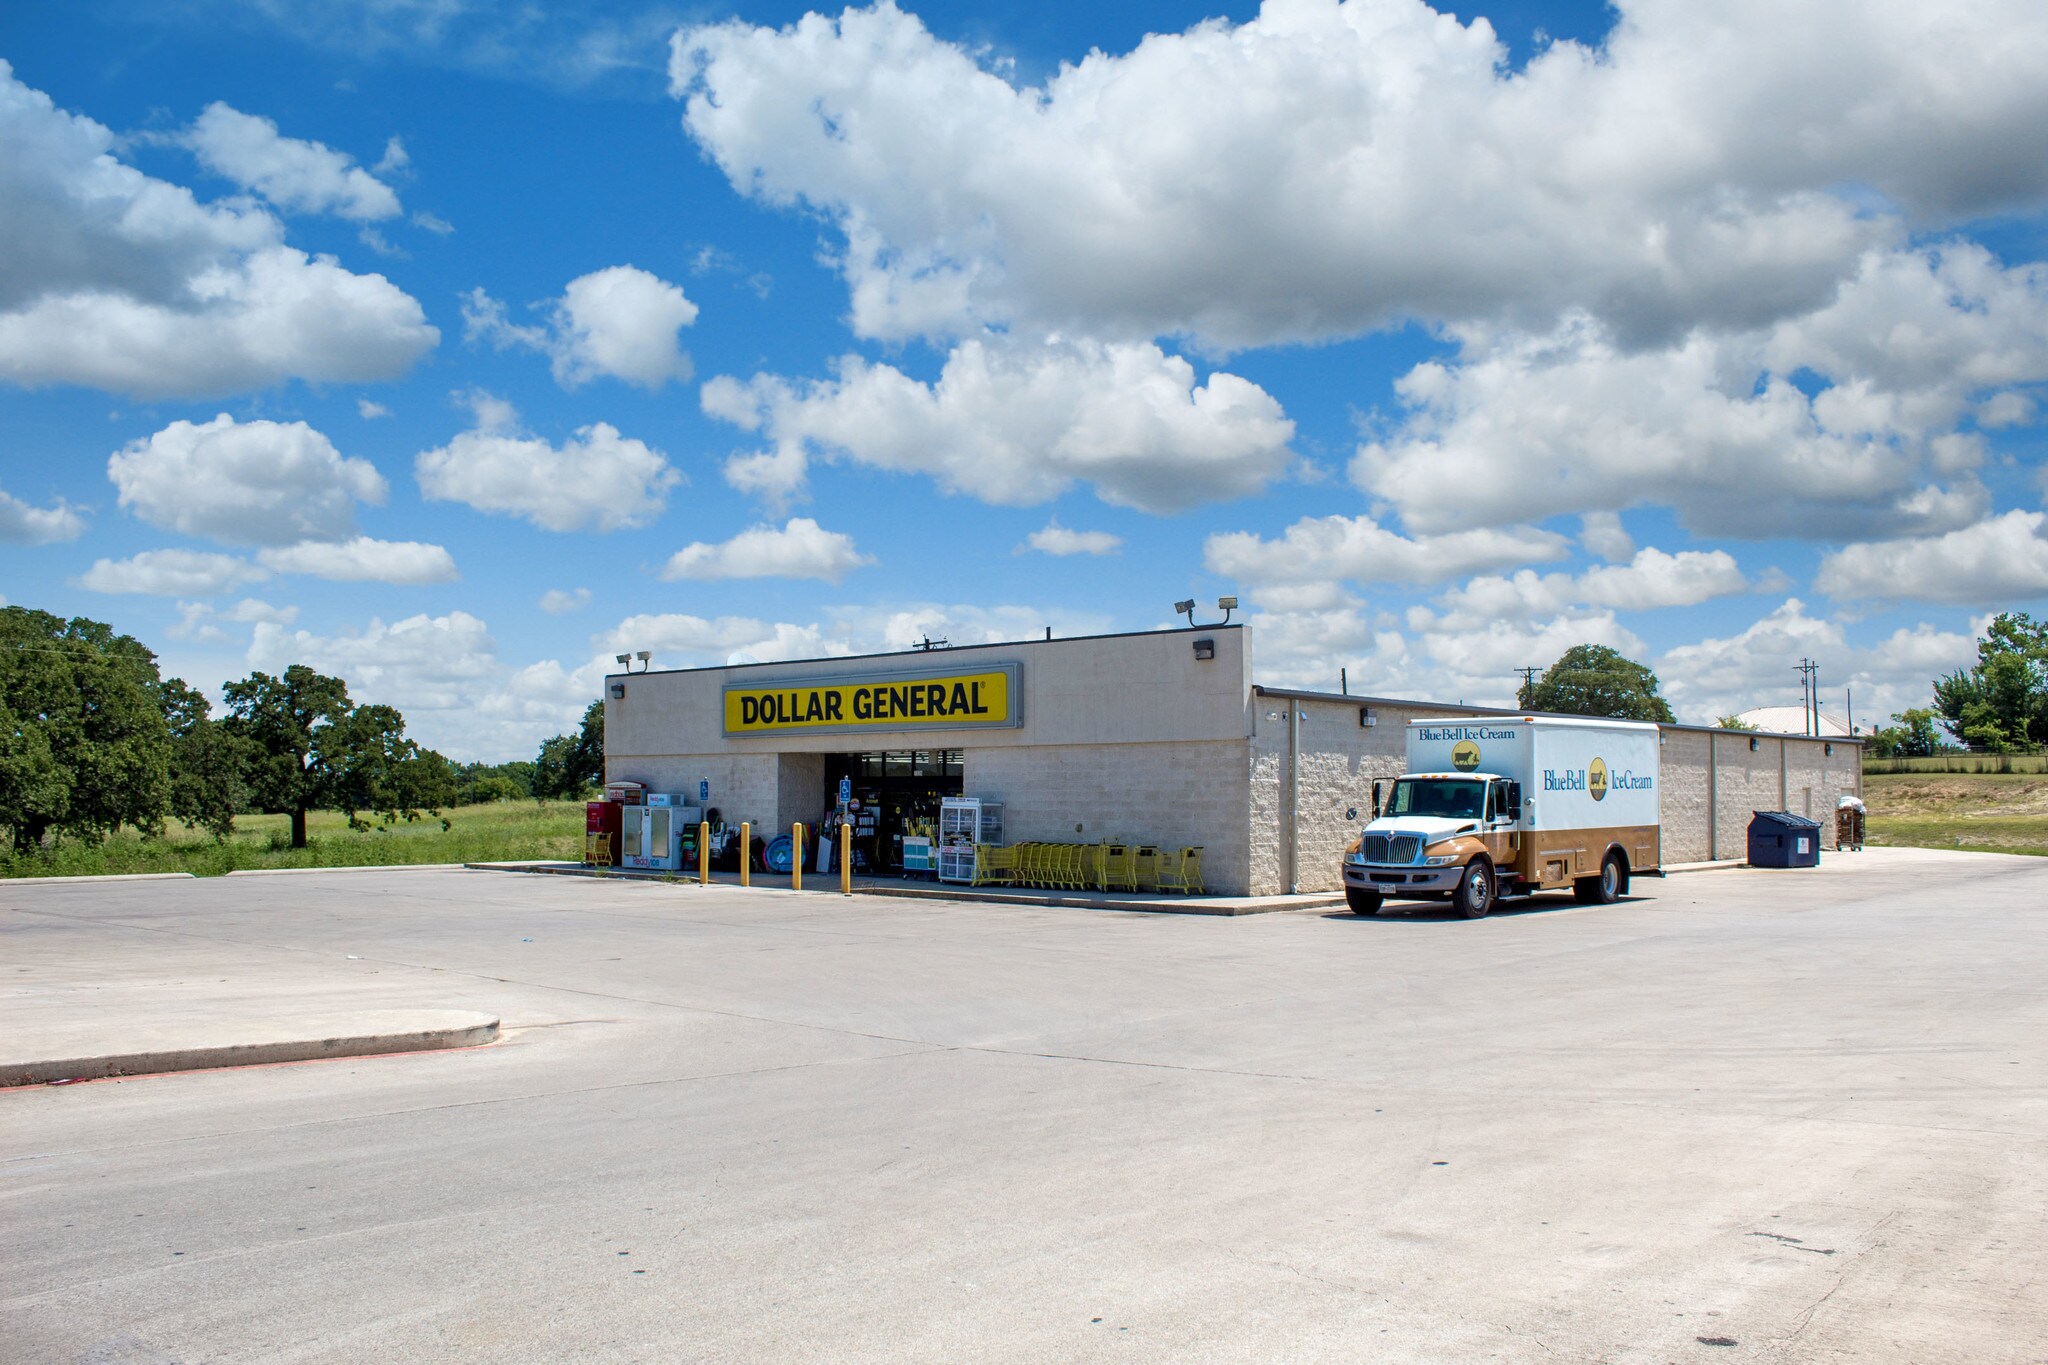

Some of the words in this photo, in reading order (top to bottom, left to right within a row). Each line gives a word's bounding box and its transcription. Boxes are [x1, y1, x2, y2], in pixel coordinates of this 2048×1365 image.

[741, 690, 844, 725] DOLLAR
[1419, 728, 1441, 741] Blue
[1442, 728, 1462, 740] Bell
[1464, 727, 1478, 740] Ice
[1479, 727, 1515, 740] Cream
[1543, 769, 1566, 791] Blue
[1566, 769, 1586, 790] Bell
[1611, 769, 1624, 790] Ice
[1624, 769, 1652, 790] Cream
